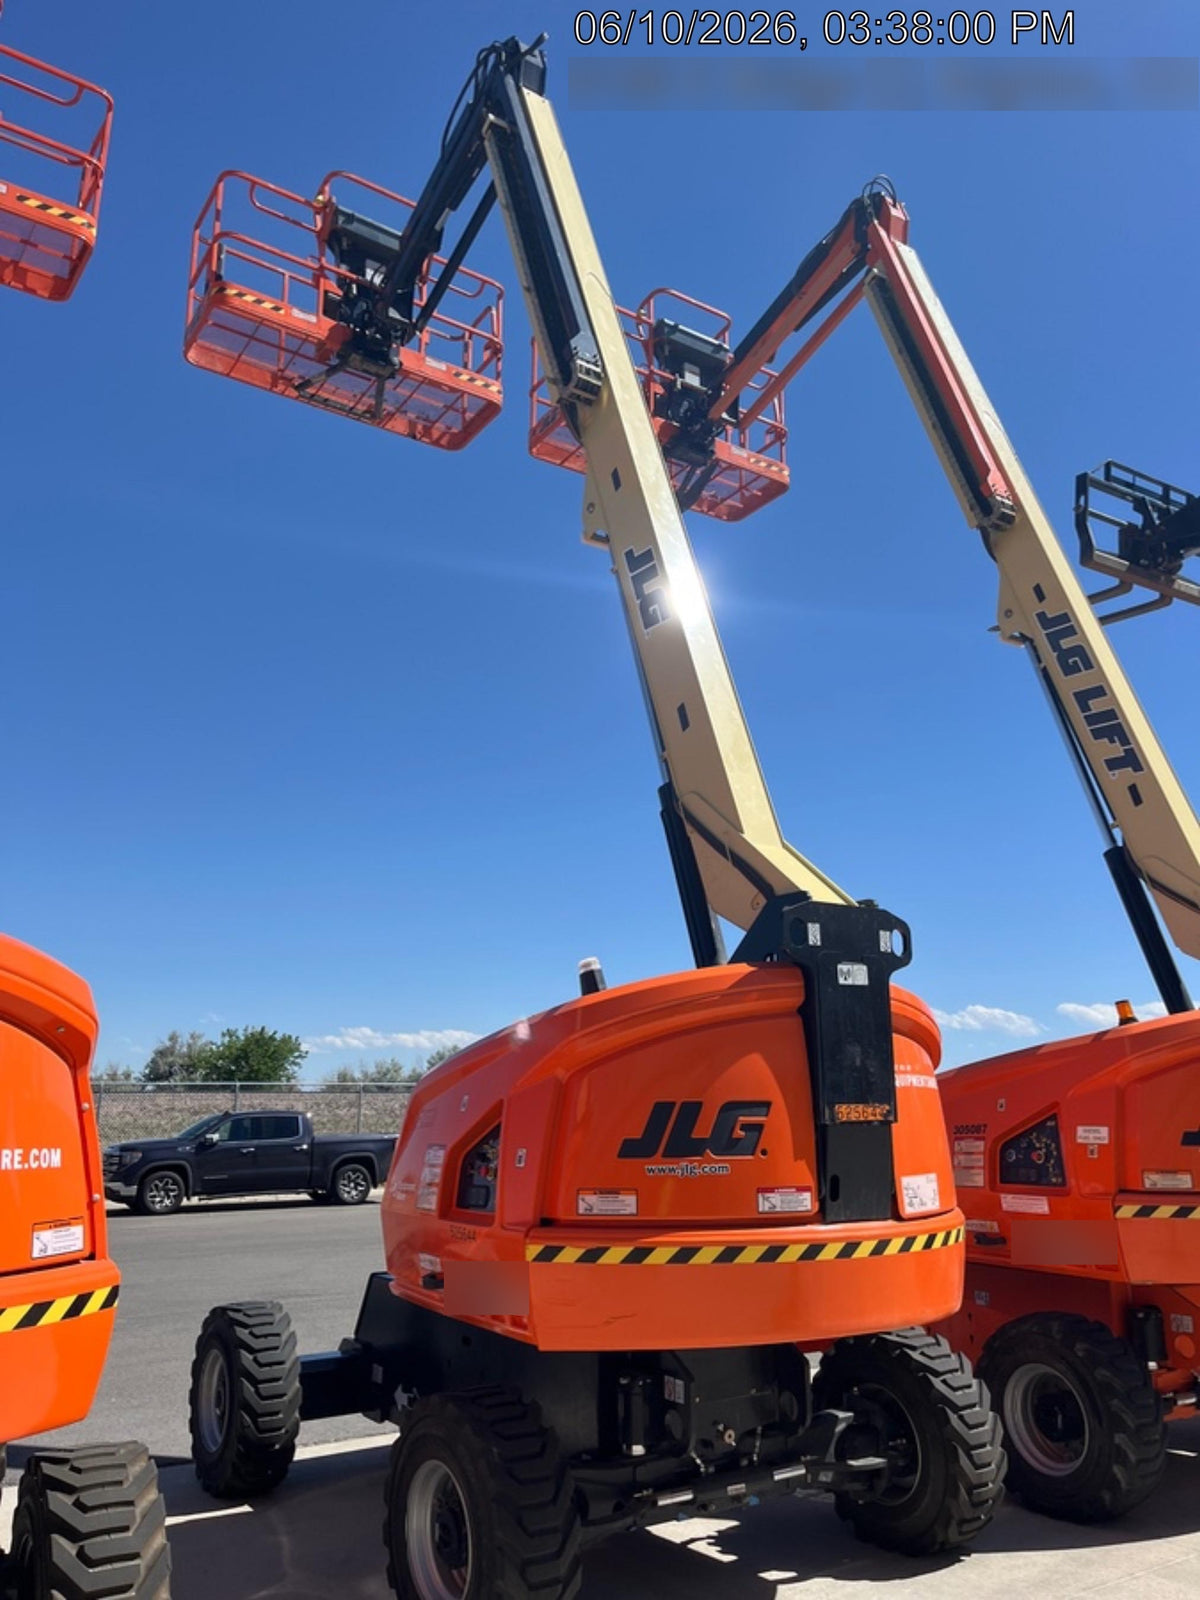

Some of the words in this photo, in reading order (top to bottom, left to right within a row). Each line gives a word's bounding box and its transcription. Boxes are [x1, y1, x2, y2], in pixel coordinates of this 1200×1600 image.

[624, 546, 672, 631] JLG
[1035, 611, 1095, 677] JLG
[1072, 684, 1144, 773] LIFT
[1, 1148, 61, 1170] RE.COM
[646, 1164, 730, 1178] www.jlg.com
